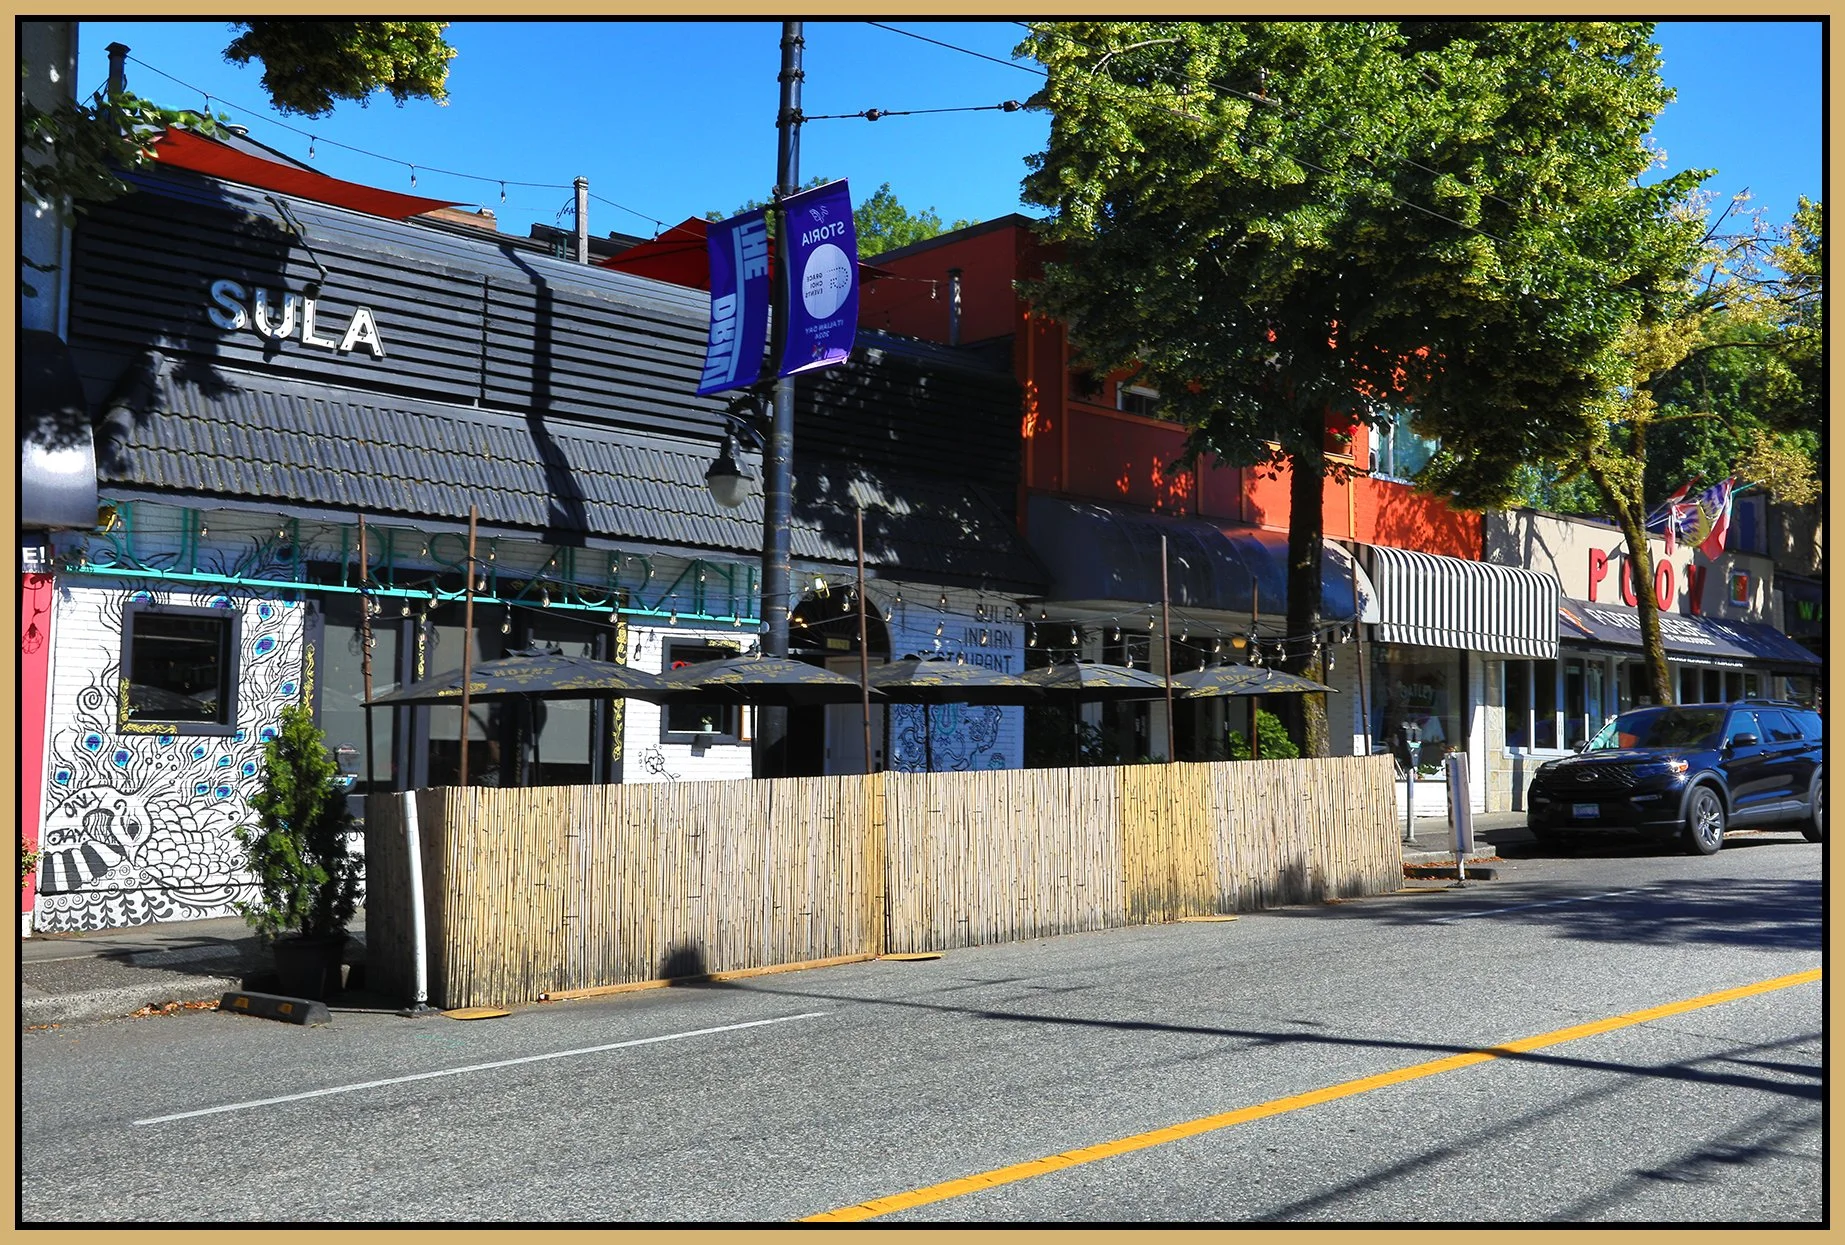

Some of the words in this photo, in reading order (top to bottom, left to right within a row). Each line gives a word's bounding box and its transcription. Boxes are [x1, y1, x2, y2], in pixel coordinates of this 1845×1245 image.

[208, 279, 388, 358] SULA
[964, 627, 1013, 649] INDIAN
[1583, 607, 1711, 638] PORTUUESE
